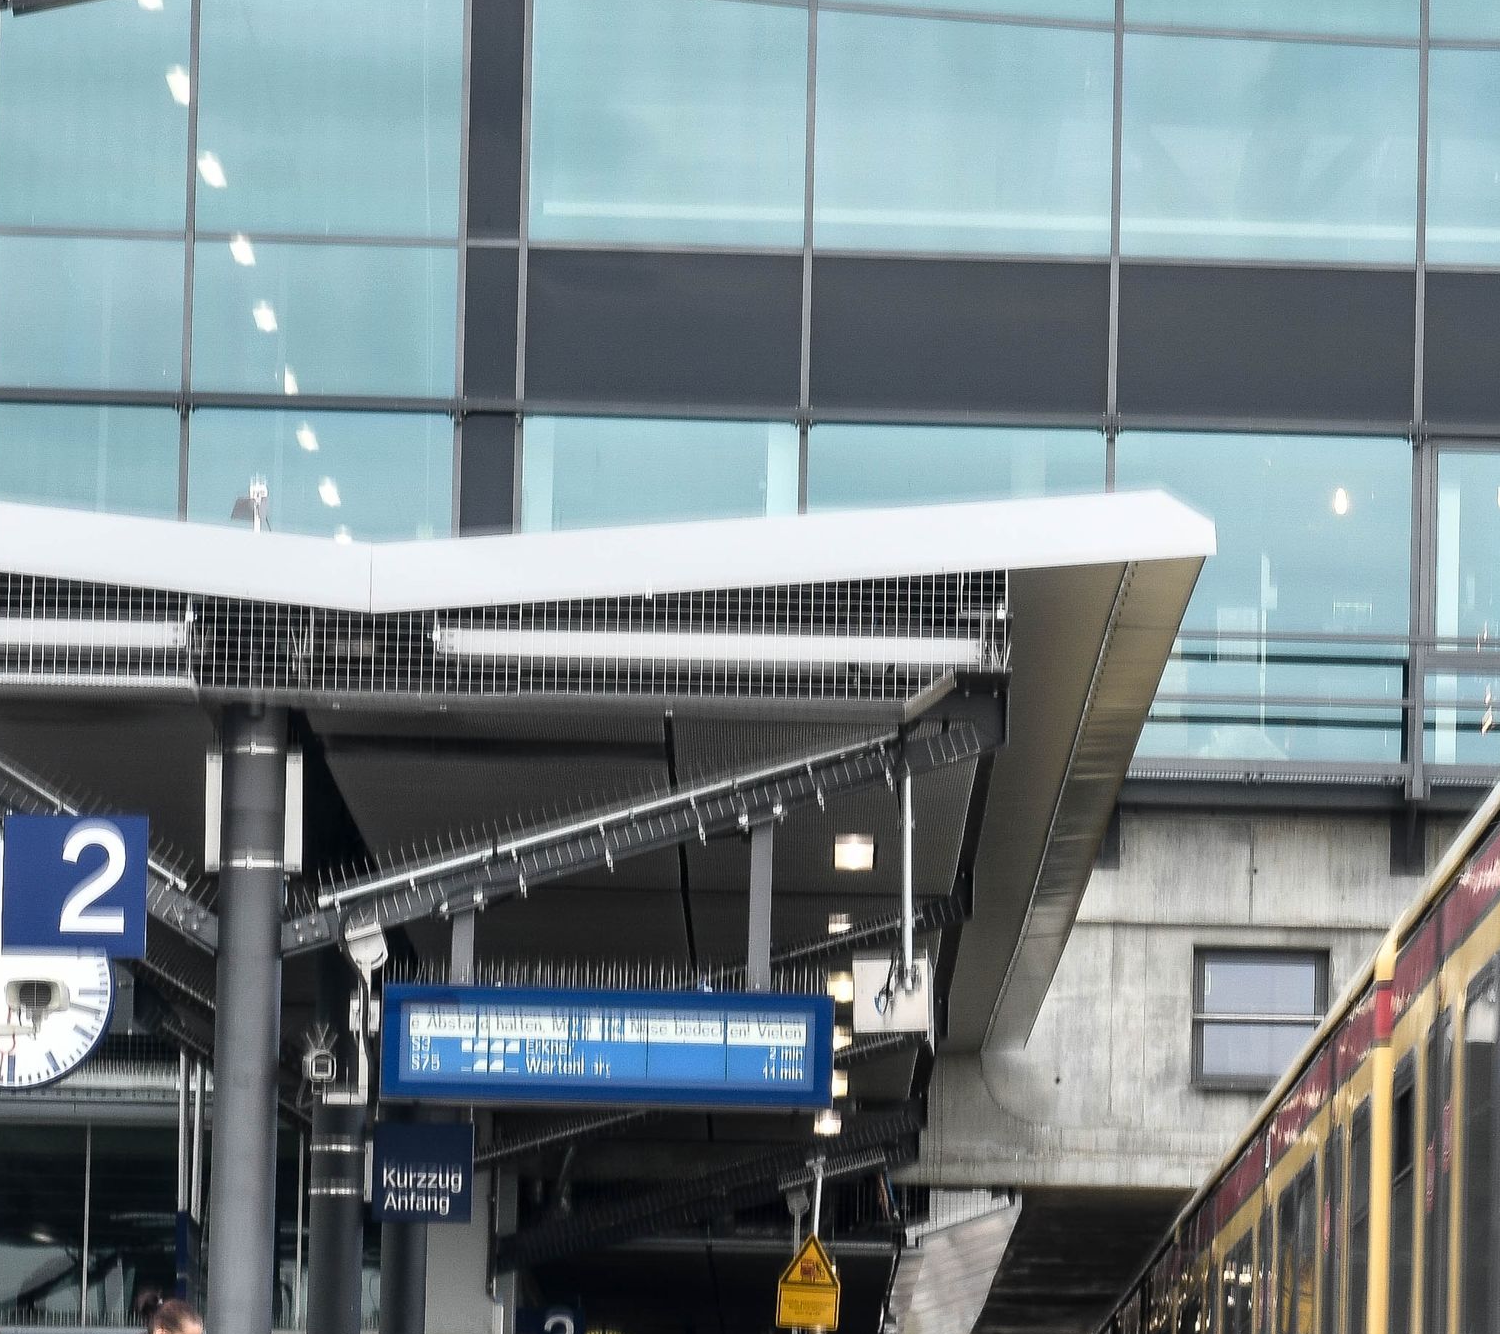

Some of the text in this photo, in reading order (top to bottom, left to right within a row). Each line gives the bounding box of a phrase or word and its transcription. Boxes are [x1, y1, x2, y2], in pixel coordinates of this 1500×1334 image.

[60, 821, 126, 934] 2
[525, 1055, 611, 1079] Wartenrg
[383, 1166, 462, 1194] Kurzzug
[384, 1190, 449, 1216] Anfang
